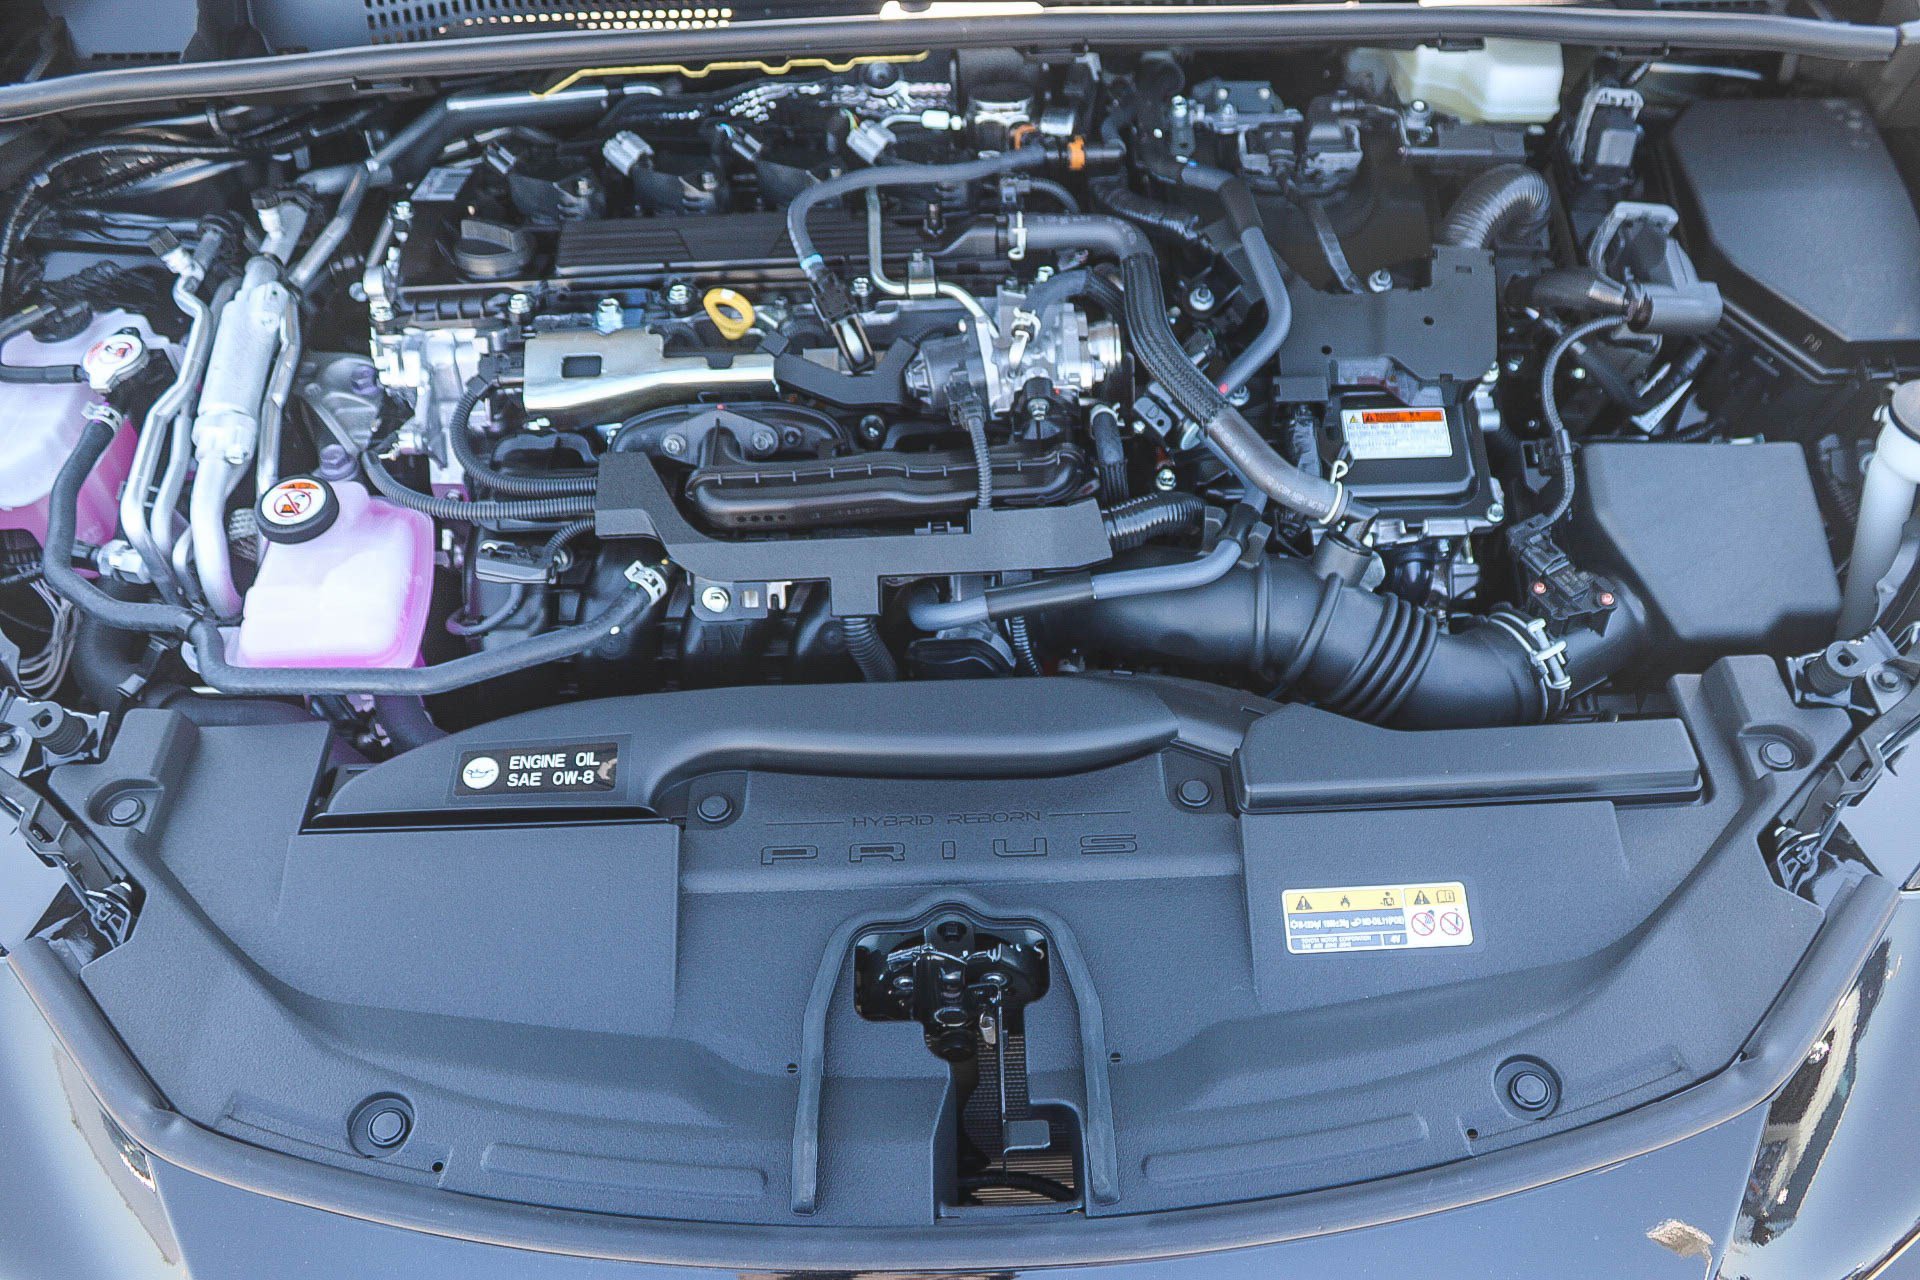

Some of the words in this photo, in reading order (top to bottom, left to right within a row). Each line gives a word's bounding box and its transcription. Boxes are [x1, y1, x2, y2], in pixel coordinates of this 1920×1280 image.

[509, 753, 566, 769] ENGINE
[575, 752, 600, 766] OIL
[507, 773, 542, 786] SAE
[552, 770, 594, 785] 0W-8
[852, 814, 934, 827] HYBRID
[946, 810, 1041, 825] REBORN
[760, 833, 1138, 865] PRIUS
